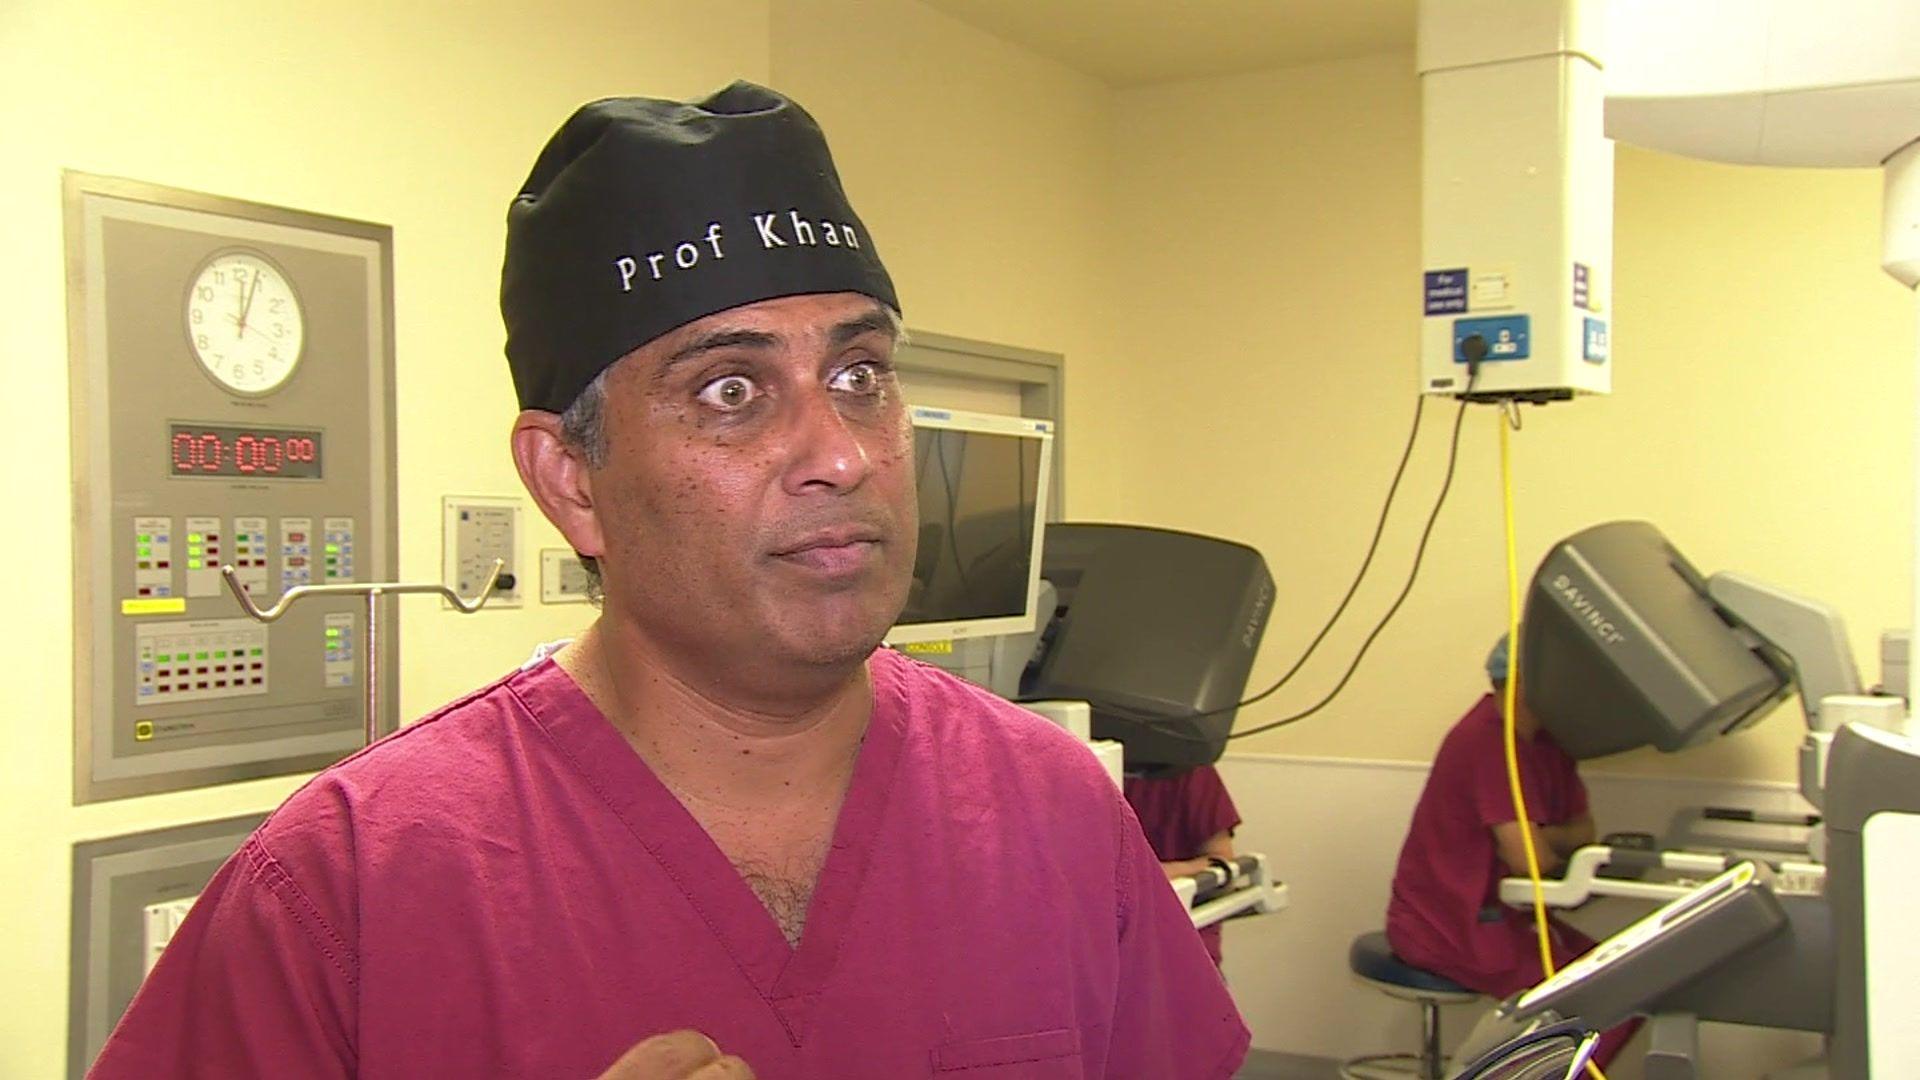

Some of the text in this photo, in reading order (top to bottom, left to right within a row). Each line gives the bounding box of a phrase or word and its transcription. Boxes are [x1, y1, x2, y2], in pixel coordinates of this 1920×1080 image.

[615, 210, 860, 291] Prof Khan
[214, 271, 225, 285] 11
[232, 268, 248, 282] 12
[198, 286, 214, 302] 10
[270, 298, 285, 314] 2
[192, 308, 203, 324] 9
[272, 323, 284, 338] 3
[197, 334, 209, 350] 8
[213, 353, 225, 369] 7
[253, 359, 264, 375] 5
[233, 363, 245, 379] 6
[1552, 574, 1621, 644] DAVINCI
